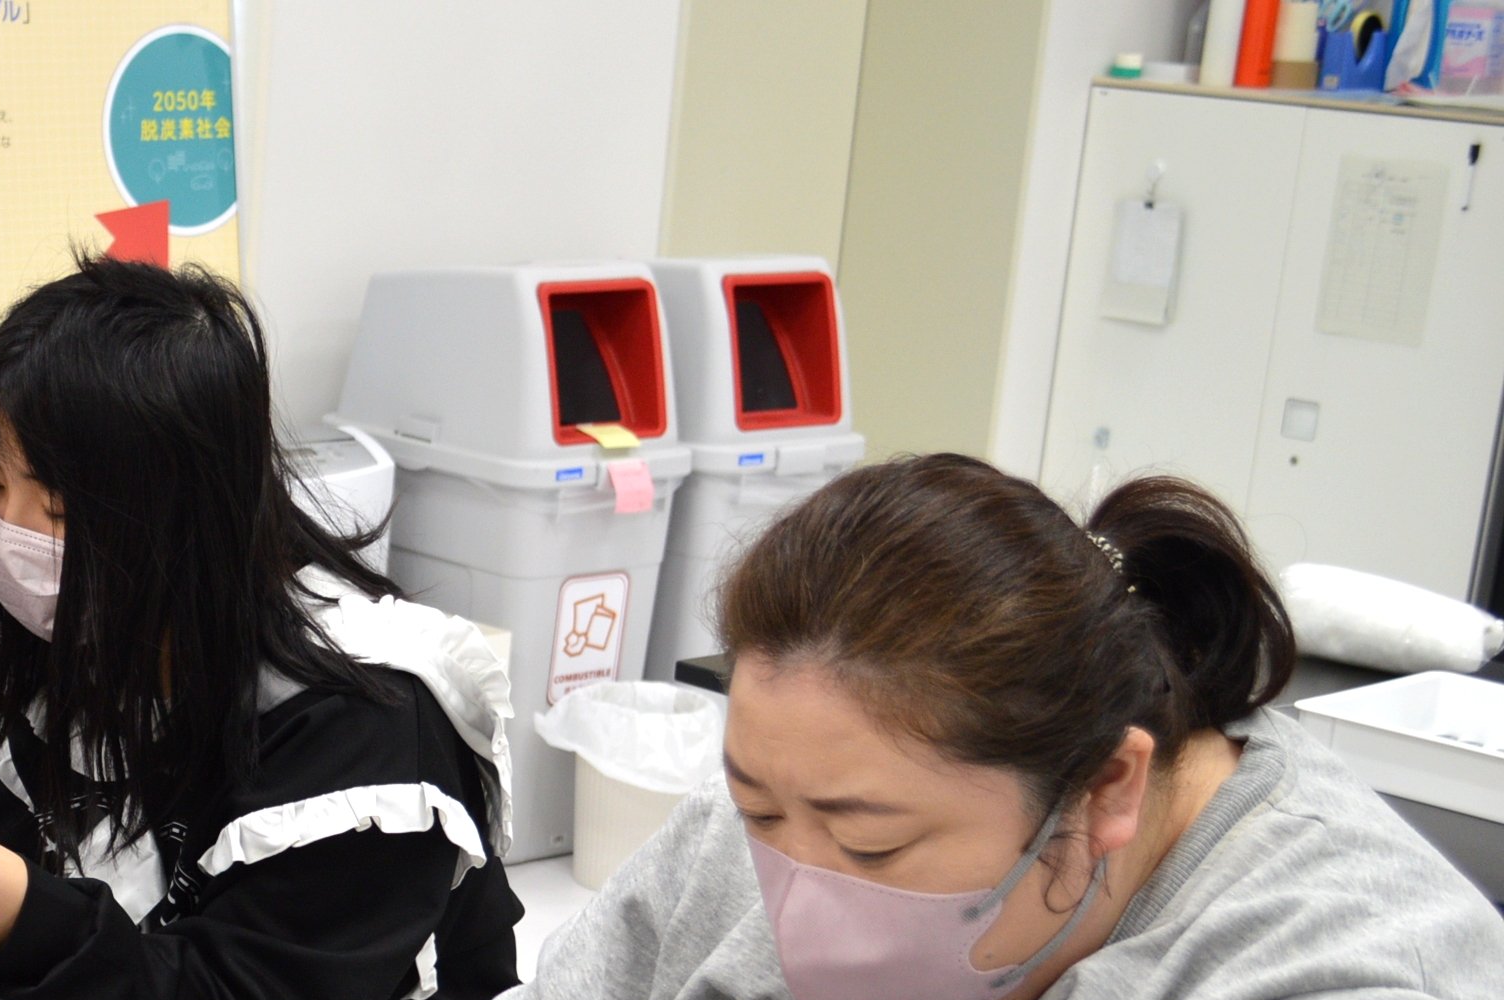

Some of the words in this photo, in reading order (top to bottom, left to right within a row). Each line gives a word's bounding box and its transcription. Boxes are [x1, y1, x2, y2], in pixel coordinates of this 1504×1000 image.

[152, 89, 216, 112] 2050年
[140, 116, 231, 141] 脱炭素社会
